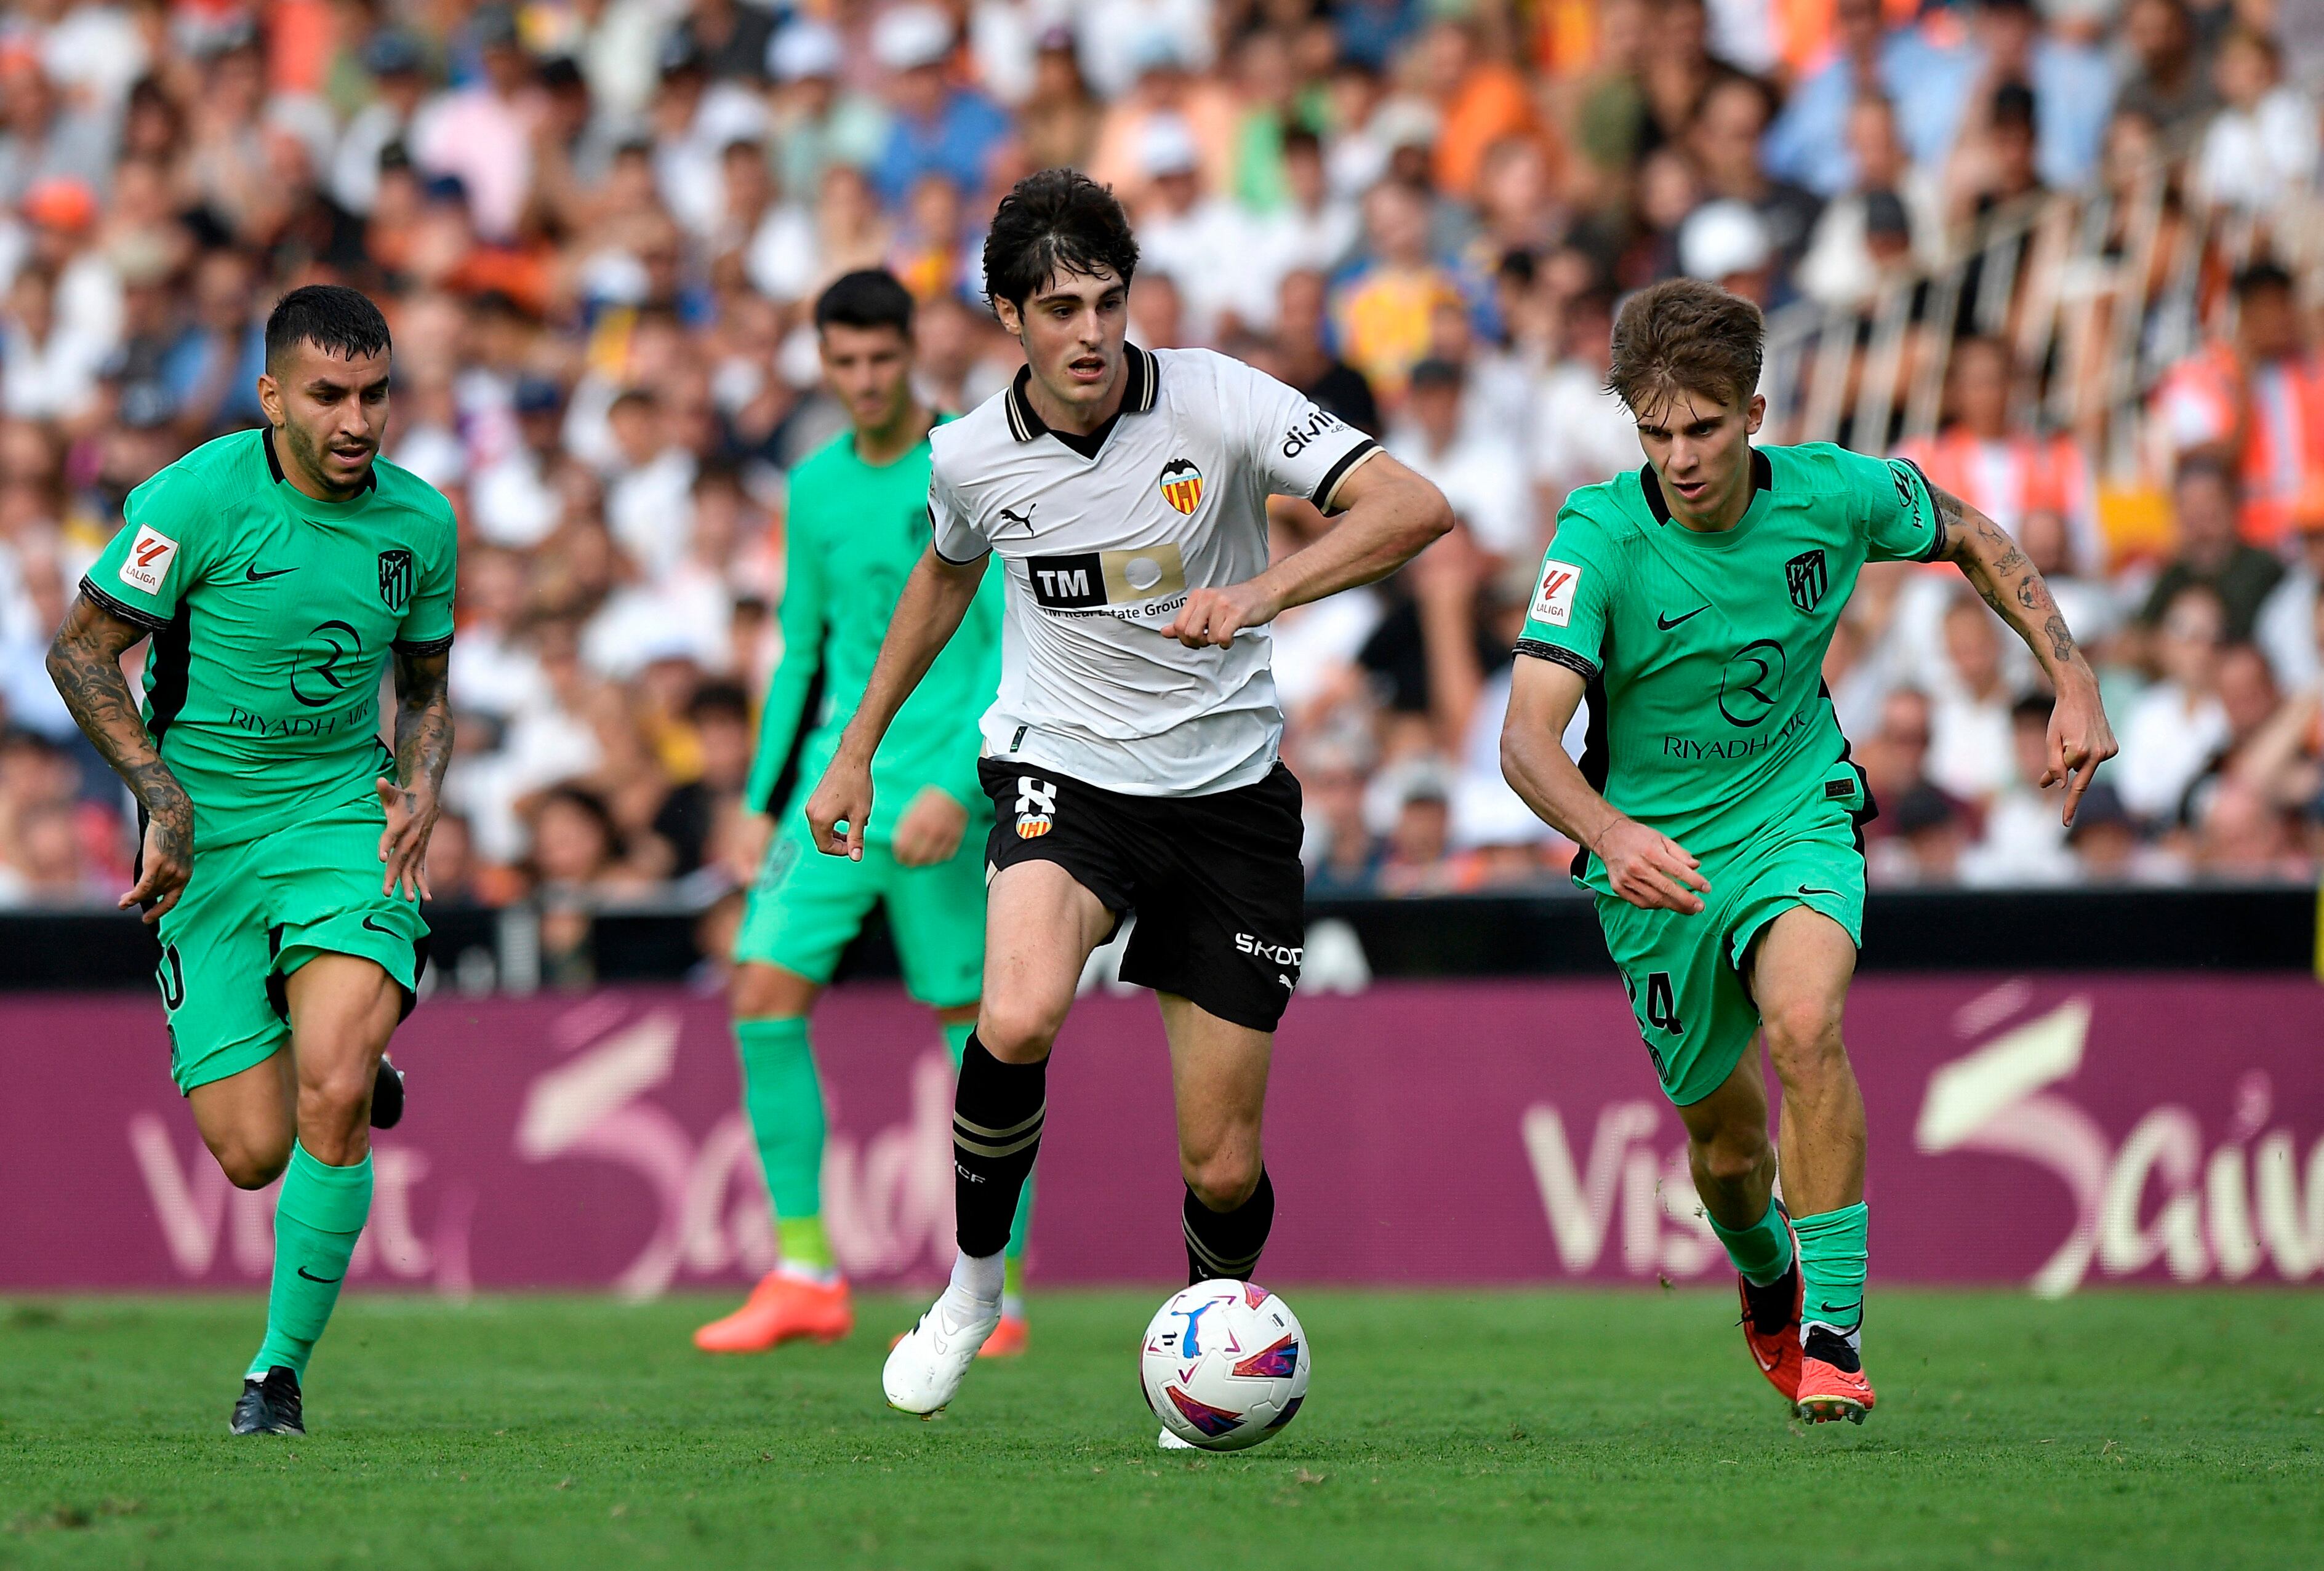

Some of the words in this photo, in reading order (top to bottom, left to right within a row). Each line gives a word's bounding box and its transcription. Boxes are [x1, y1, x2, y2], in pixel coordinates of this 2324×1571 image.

[126, 566, 156, 586] LALIGA
[1037, 569, 1090, 598] TM
[1145, 596, 1187, 616] Group
[1537, 603, 1563, 617] LALIGA
[229, 707, 336, 737] RIYADH
[340, 698, 369, 731] AIR
[1664, 734, 1768, 760] RIYADH
[1235, 932, 1304, 965] SKOD
[955, 1160, 985, 1183] CF
